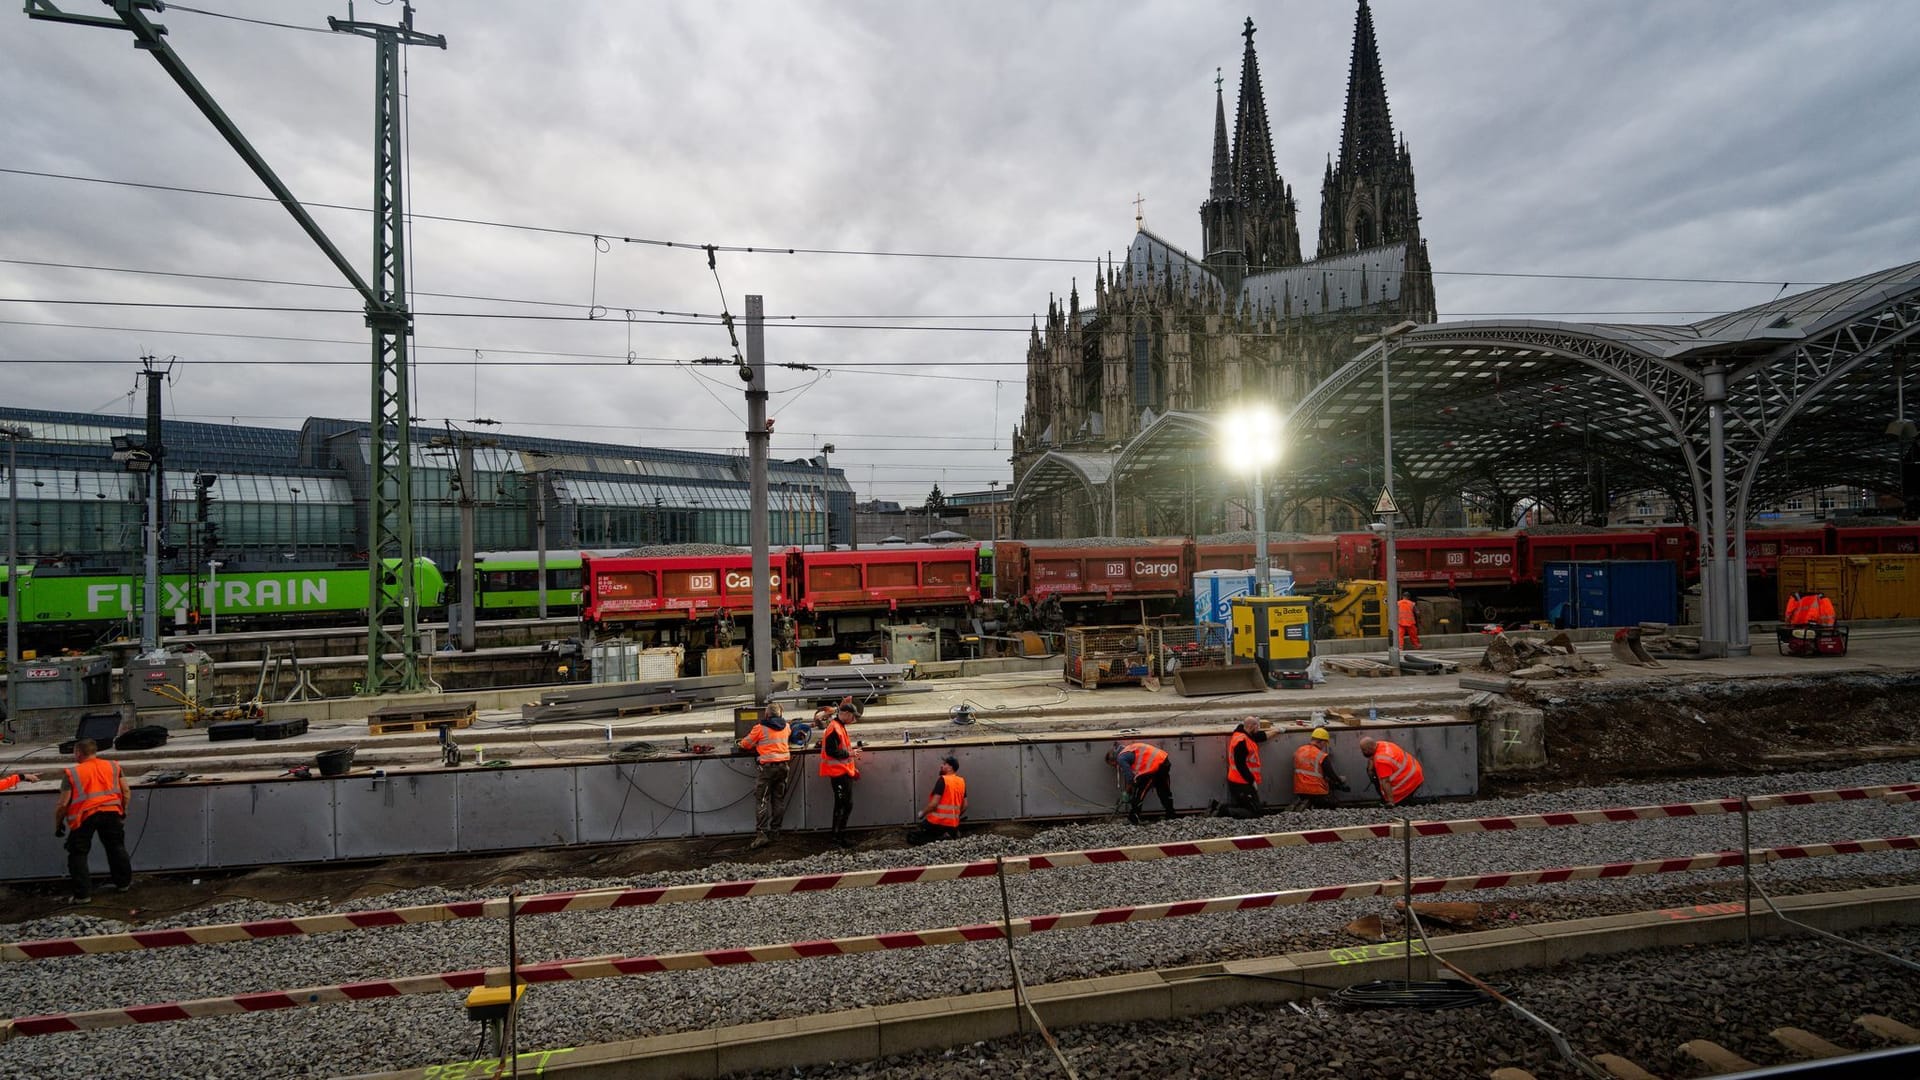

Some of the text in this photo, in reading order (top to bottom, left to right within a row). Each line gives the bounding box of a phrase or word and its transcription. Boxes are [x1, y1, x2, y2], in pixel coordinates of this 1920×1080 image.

[1448, 552, 1463, 565] DB
[1107, 560, 1178, 577] DB Cargo
[691, 572, 781, 589] DB Cao
[87, 578, 328, 612] FLXTRAIN
